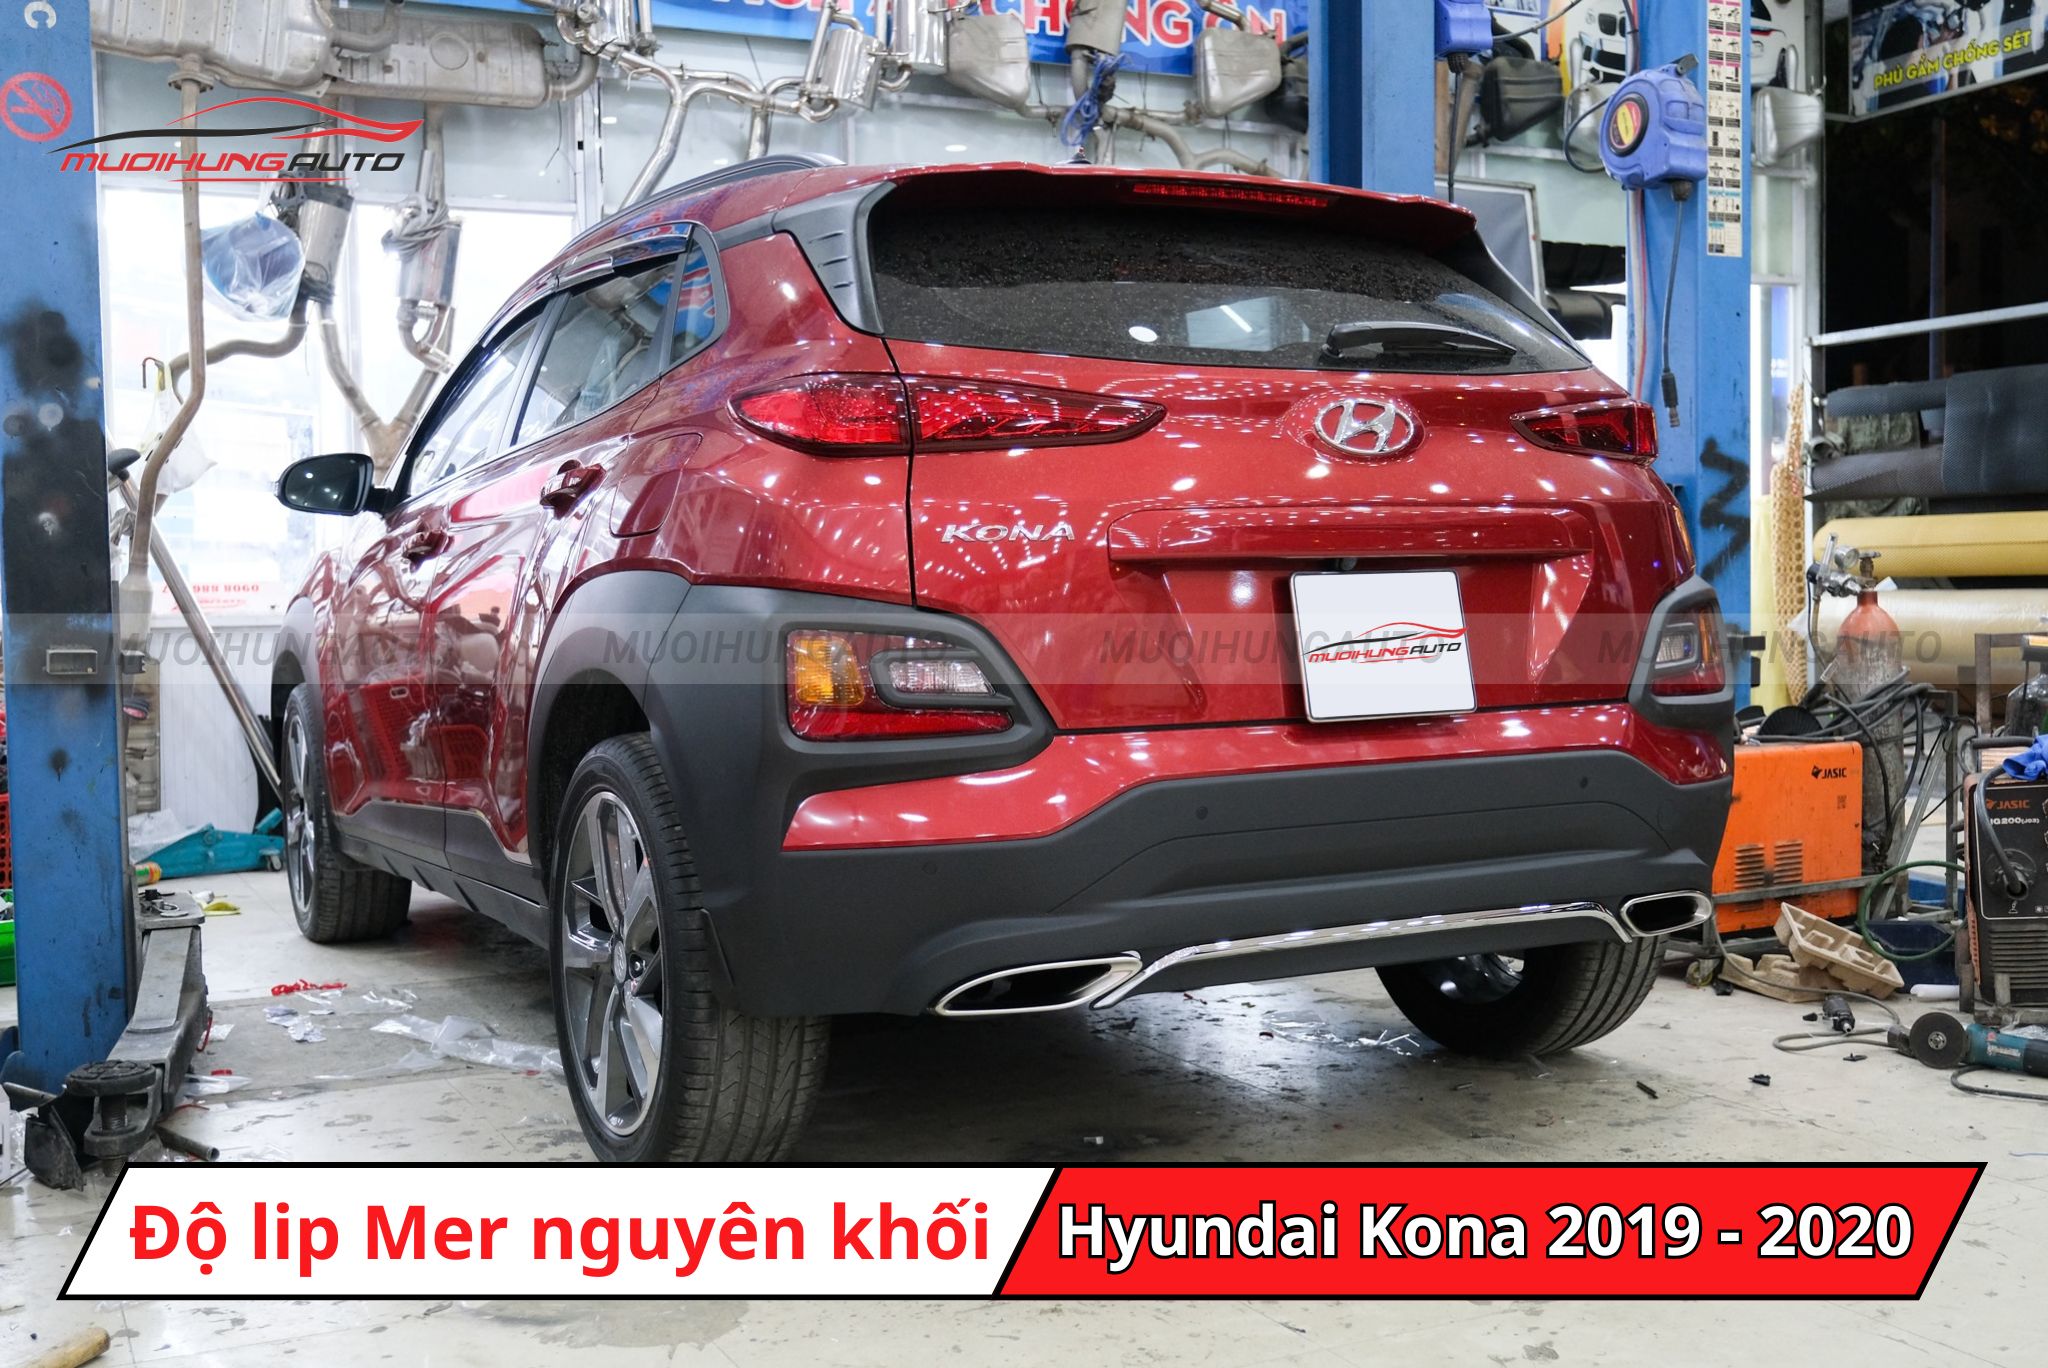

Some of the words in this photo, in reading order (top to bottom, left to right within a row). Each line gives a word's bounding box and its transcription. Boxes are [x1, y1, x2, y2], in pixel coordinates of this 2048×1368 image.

[2003, 29, 2032, 53] SÉT
[941, 523, 1076, 543] KONA
[1822, 767, 1847, 779] JASIC
[1996, 800, 2030, 810] JASIC
